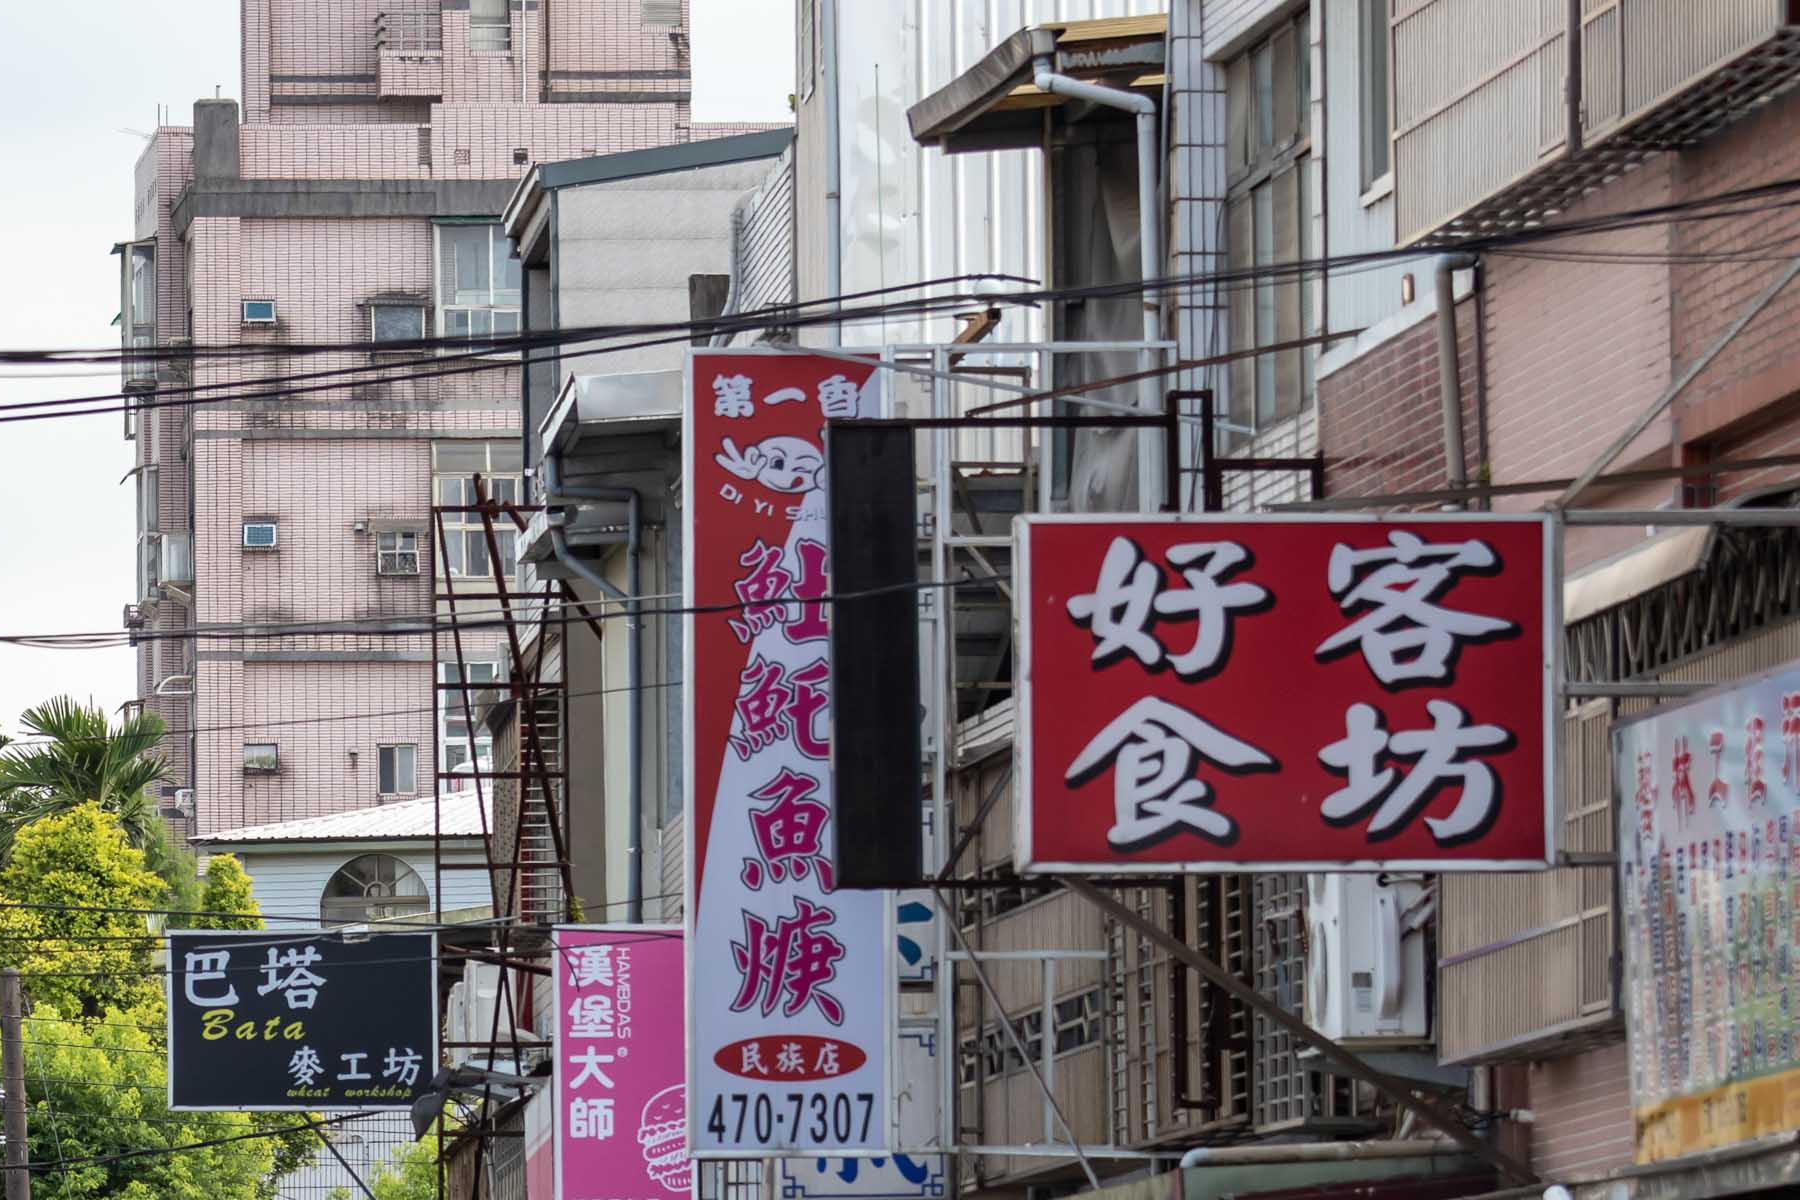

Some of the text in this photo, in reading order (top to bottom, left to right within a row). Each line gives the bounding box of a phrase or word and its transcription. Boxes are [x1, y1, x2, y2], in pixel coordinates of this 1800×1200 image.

[719, 482, 744, 505] DI
[752, 500, 776, 518] YI
[1067, 529, 1518, 690] 好客
[1065, 696, 1515, 850] 食坊
[184, 945, 327, 1009] 巴塔
[201, 1009, 307, 1042] Bata
[568, 944, 616, 1142] 漢堡大師
[287, 1045, 423, 1086] 麥工坊
[740, 1043, 841, 1075] 民族店
[344, 1085, 413, 1099] workshop
